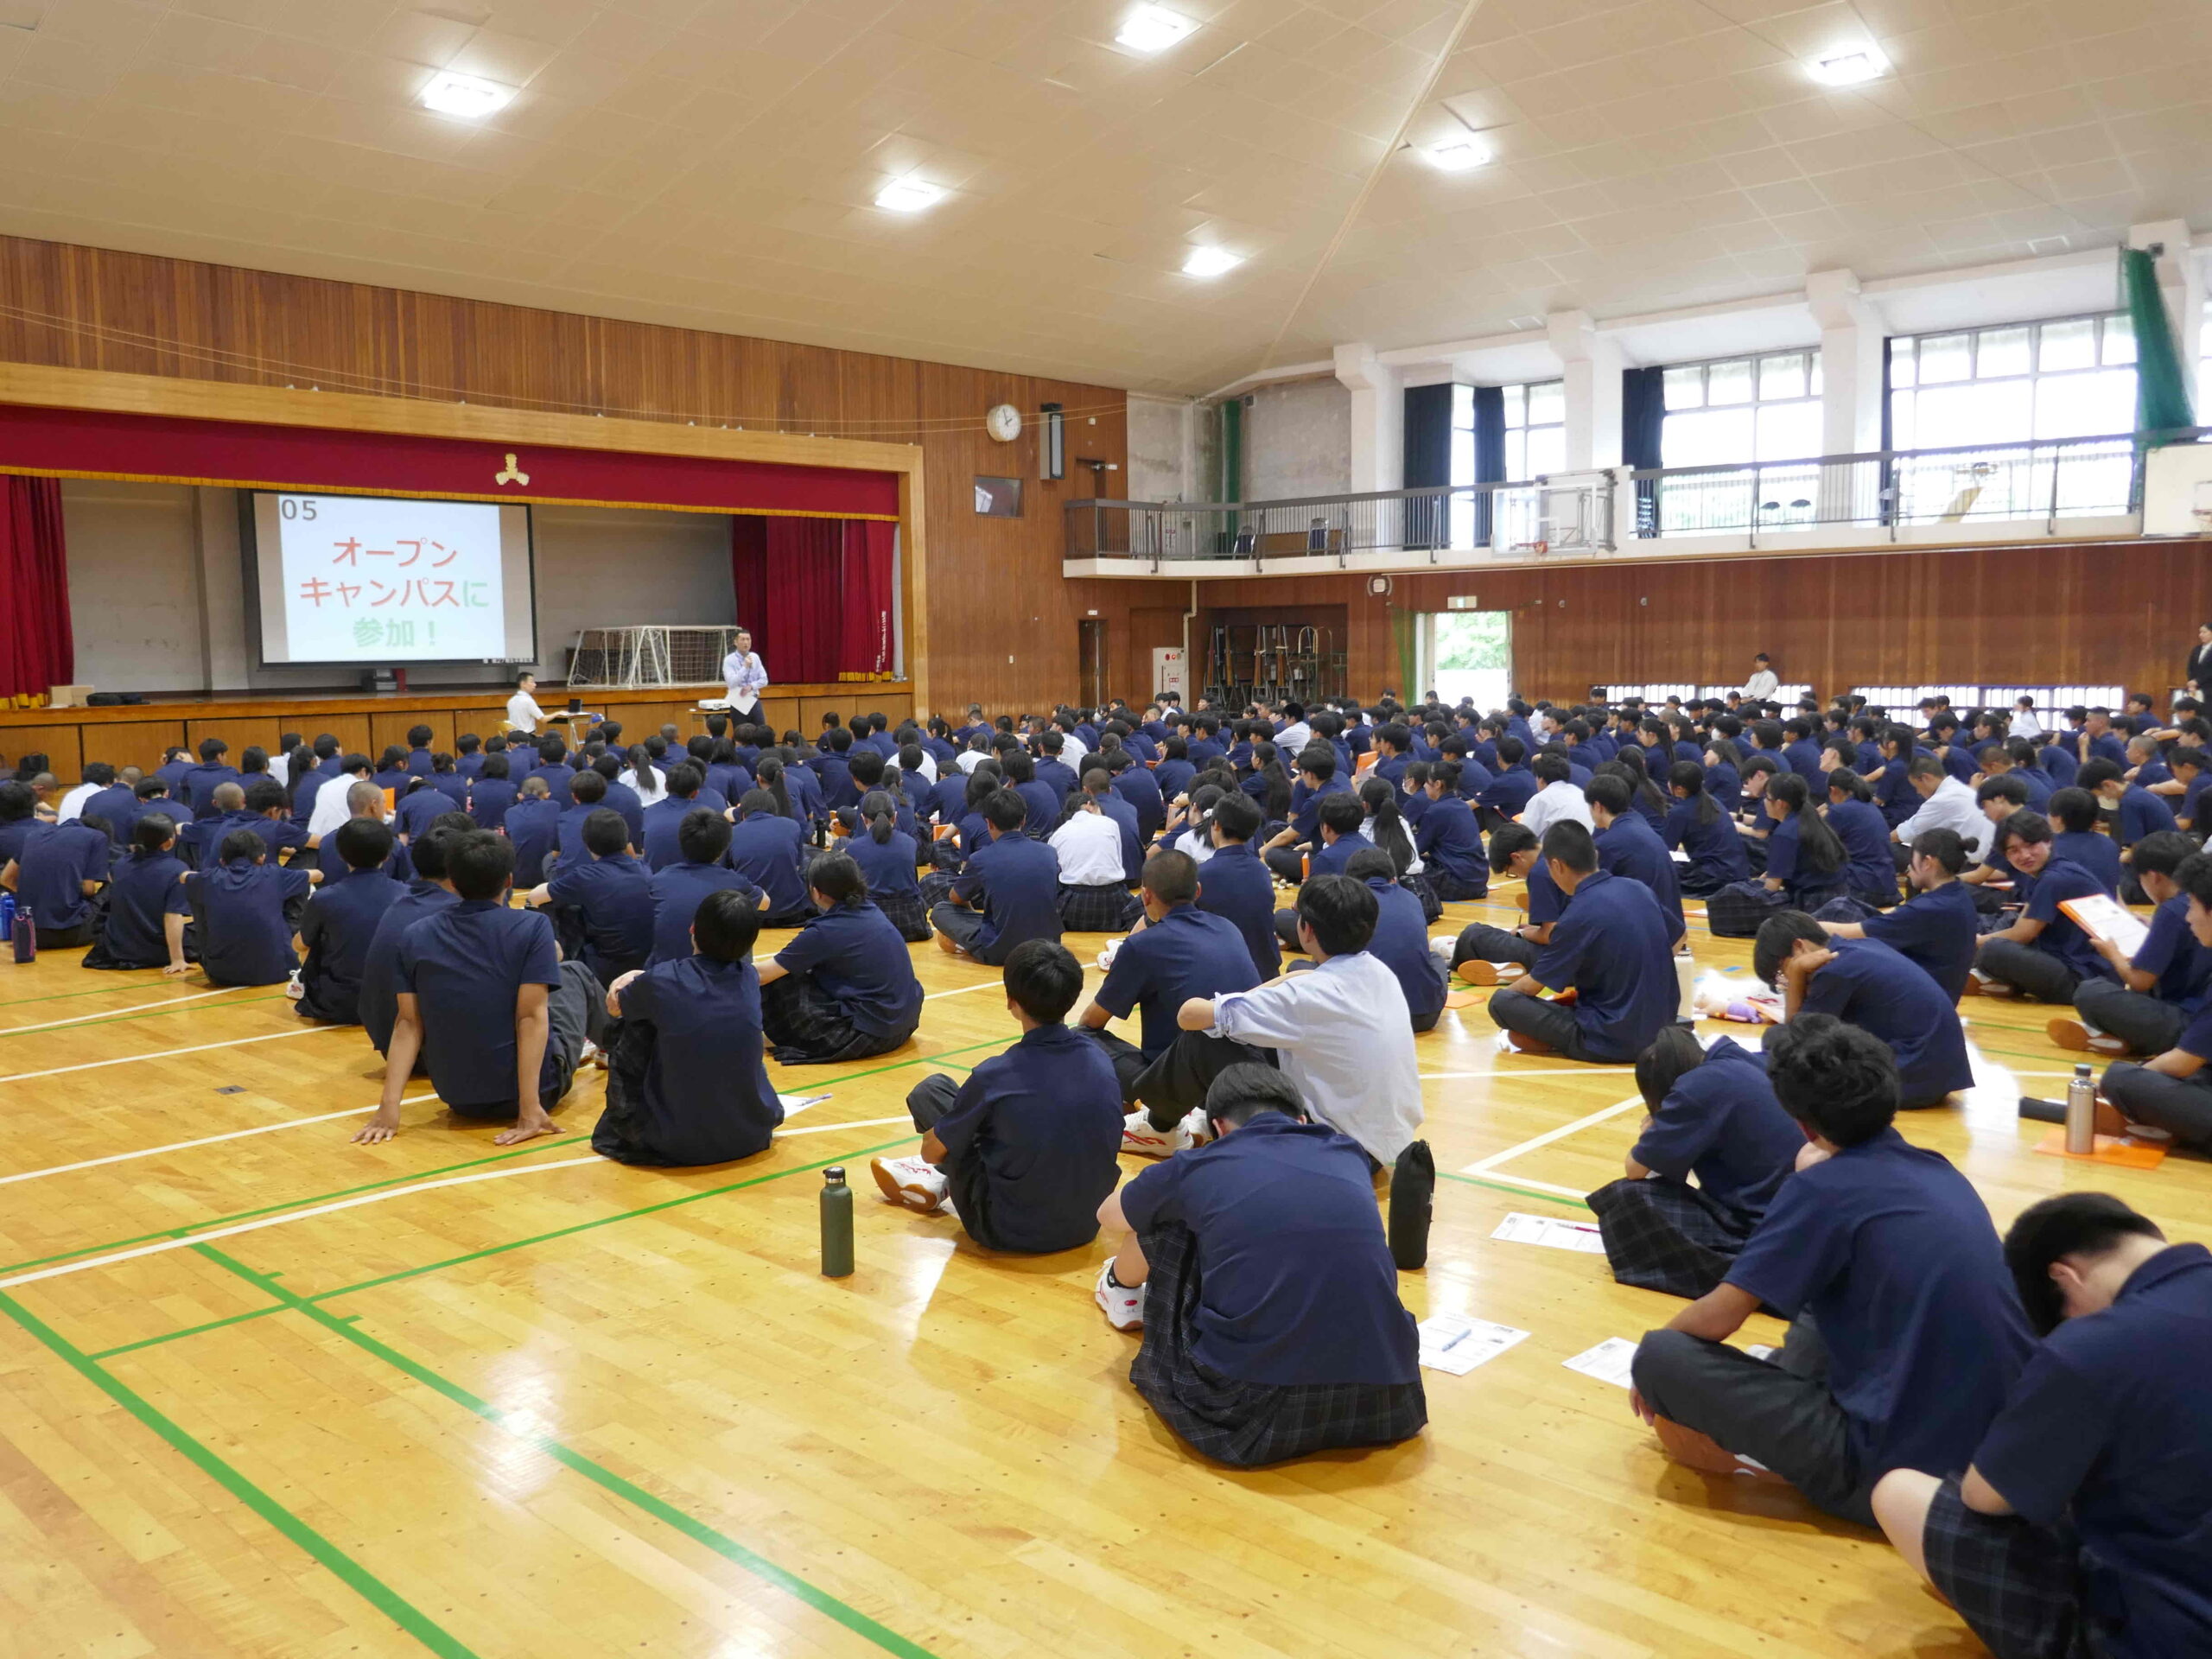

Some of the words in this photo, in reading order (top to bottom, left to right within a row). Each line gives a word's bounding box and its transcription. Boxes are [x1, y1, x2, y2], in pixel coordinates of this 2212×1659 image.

[282, 499, 317, 520] 05
[333, 537, 456, 567] オープン
[301, 576, 489, 607] キャンパスに
